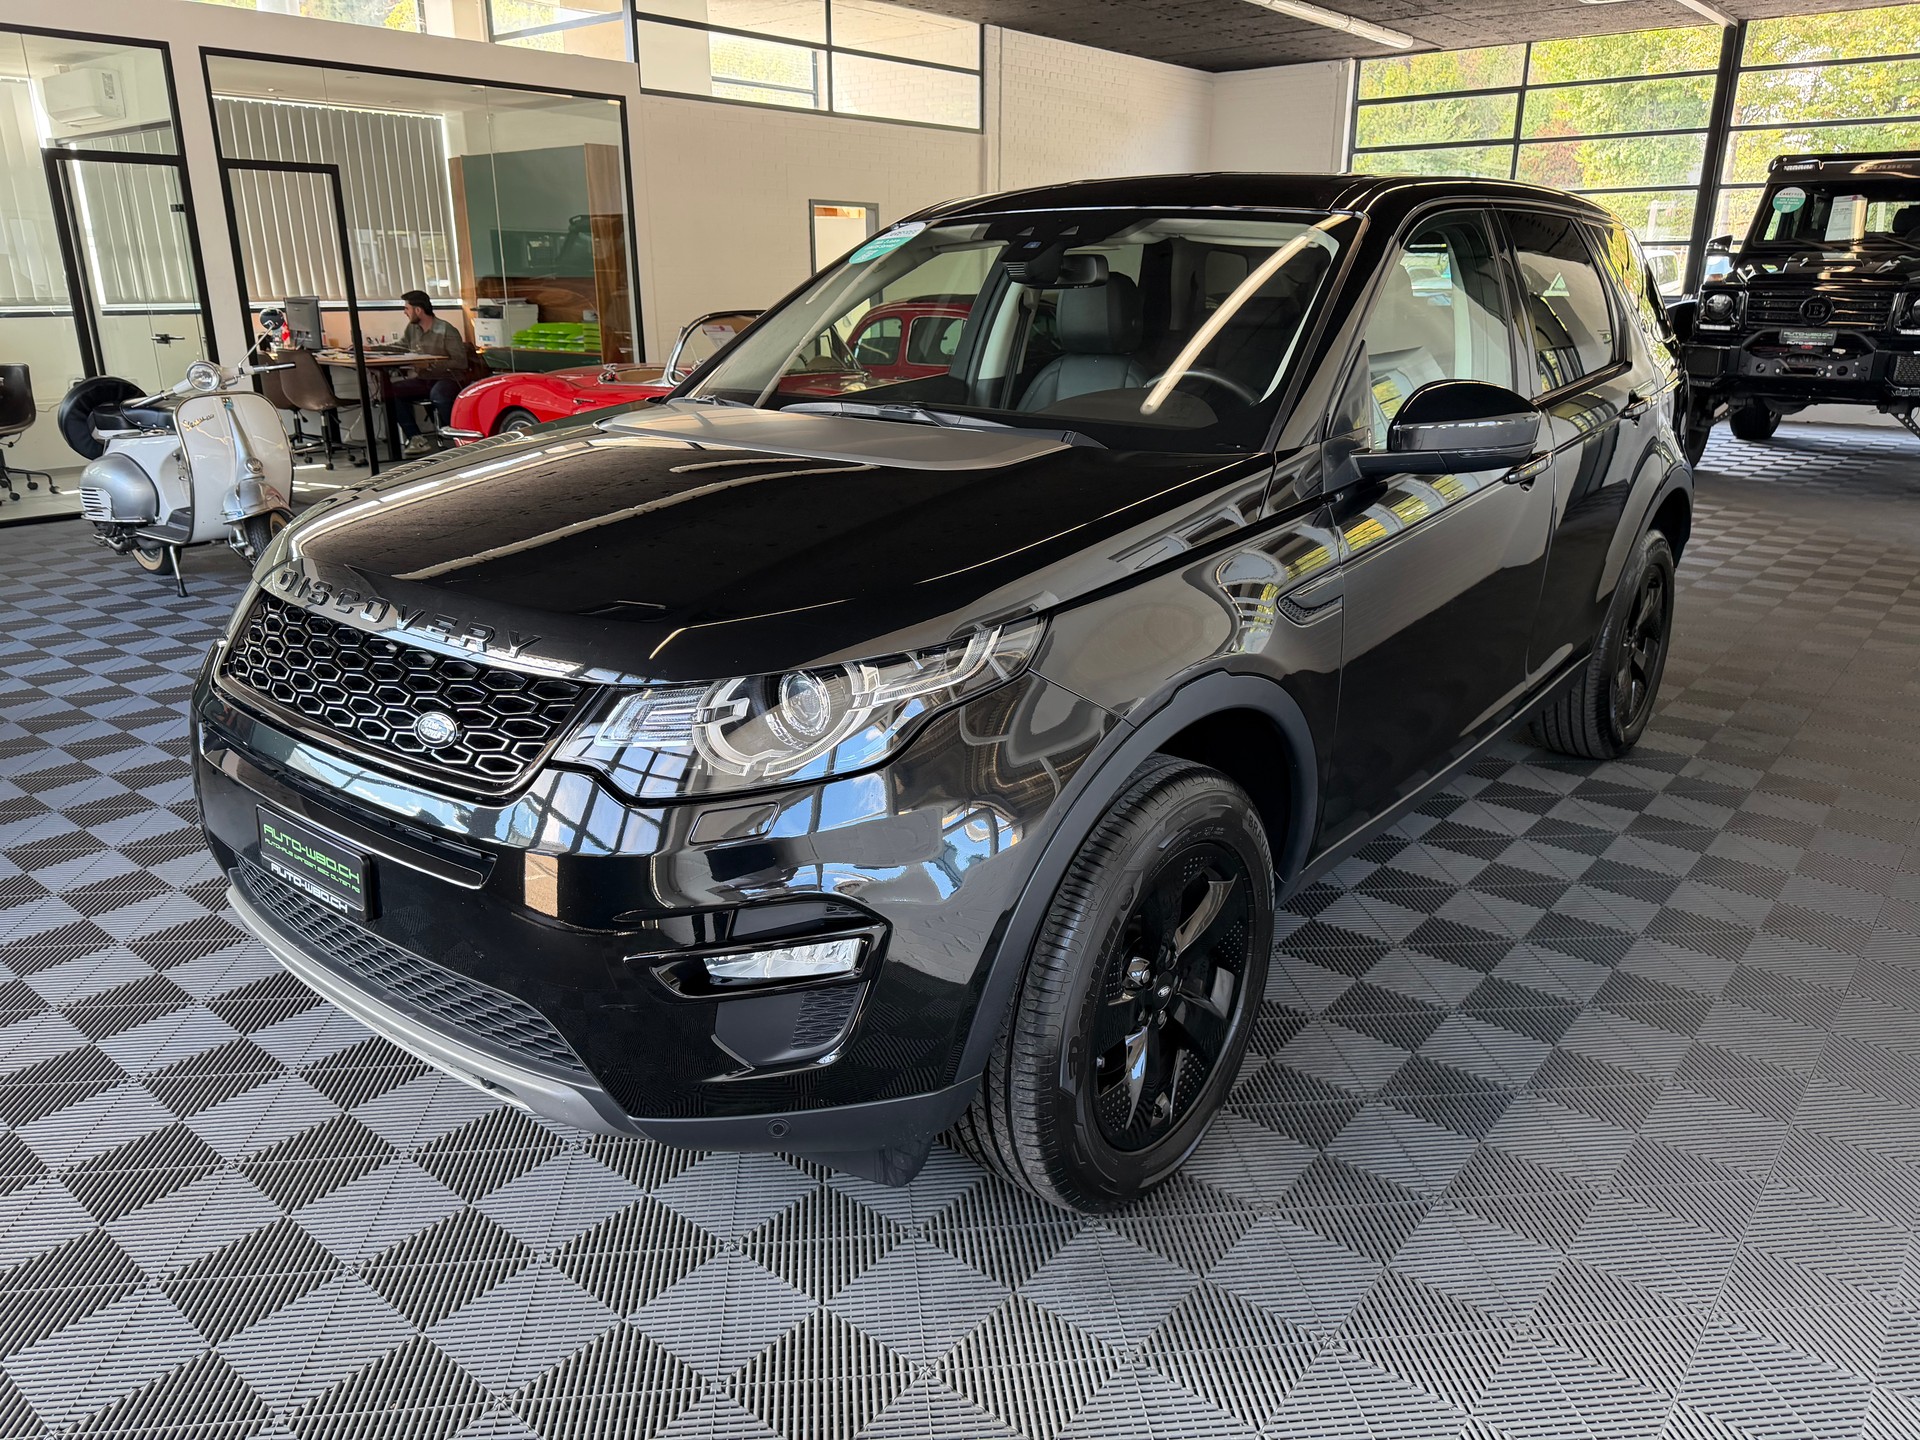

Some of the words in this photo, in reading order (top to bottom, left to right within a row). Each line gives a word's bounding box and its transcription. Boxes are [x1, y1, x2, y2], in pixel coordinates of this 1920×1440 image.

[278, 568, 542, 659] DISCOVERY
[263, 823, 360, 884] AUTO-WBO.CH
[264, 838, 293, 857] AUTOHAUS
[330, 874, 351, 888] OLTEN
[351, 885, 361, 893] AG
[270, 862, 348, 913] AUTO-WBO.CH
